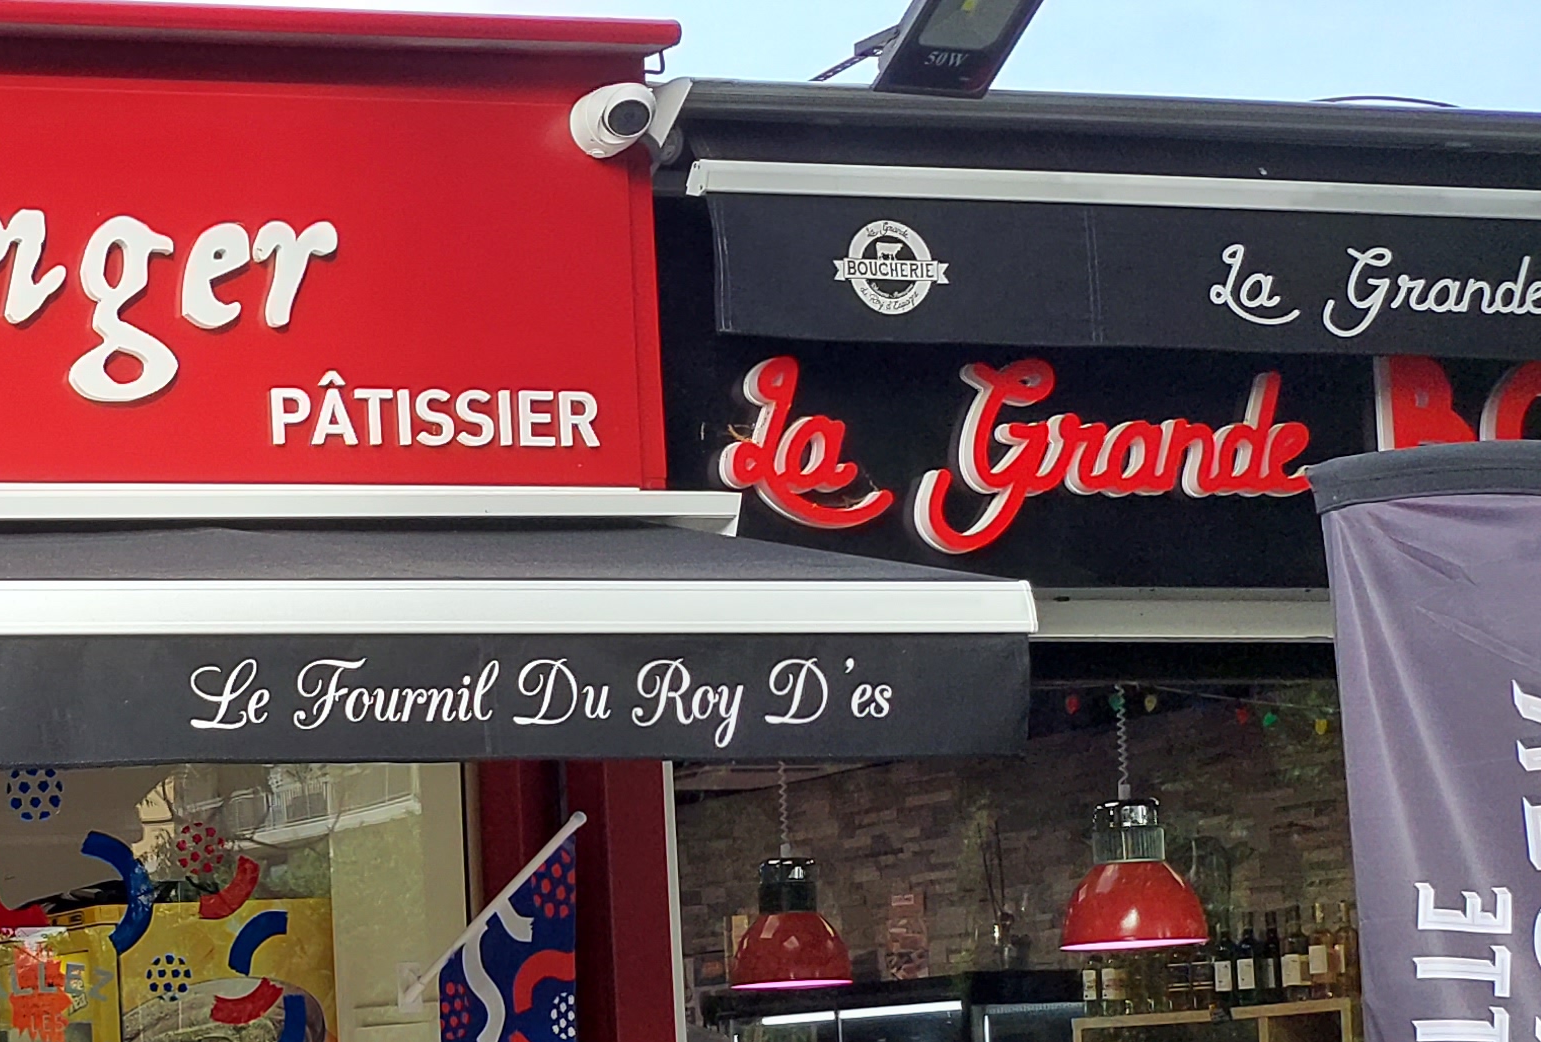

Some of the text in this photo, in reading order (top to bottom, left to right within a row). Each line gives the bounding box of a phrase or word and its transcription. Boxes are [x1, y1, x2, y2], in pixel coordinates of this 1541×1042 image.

[924, 51, 968, 68] 50W
[846, 260, 935, 279] BOUCHERIE
[1210, 245, 1541, 337] La Grande
[270, 371, 600, 447] PÂTISSIER
[719, 356, 894, 528] La
[915, 358, 1310, 553] Grande
[189, 656, 893, 748] Le Fournil Du Roy D'es
